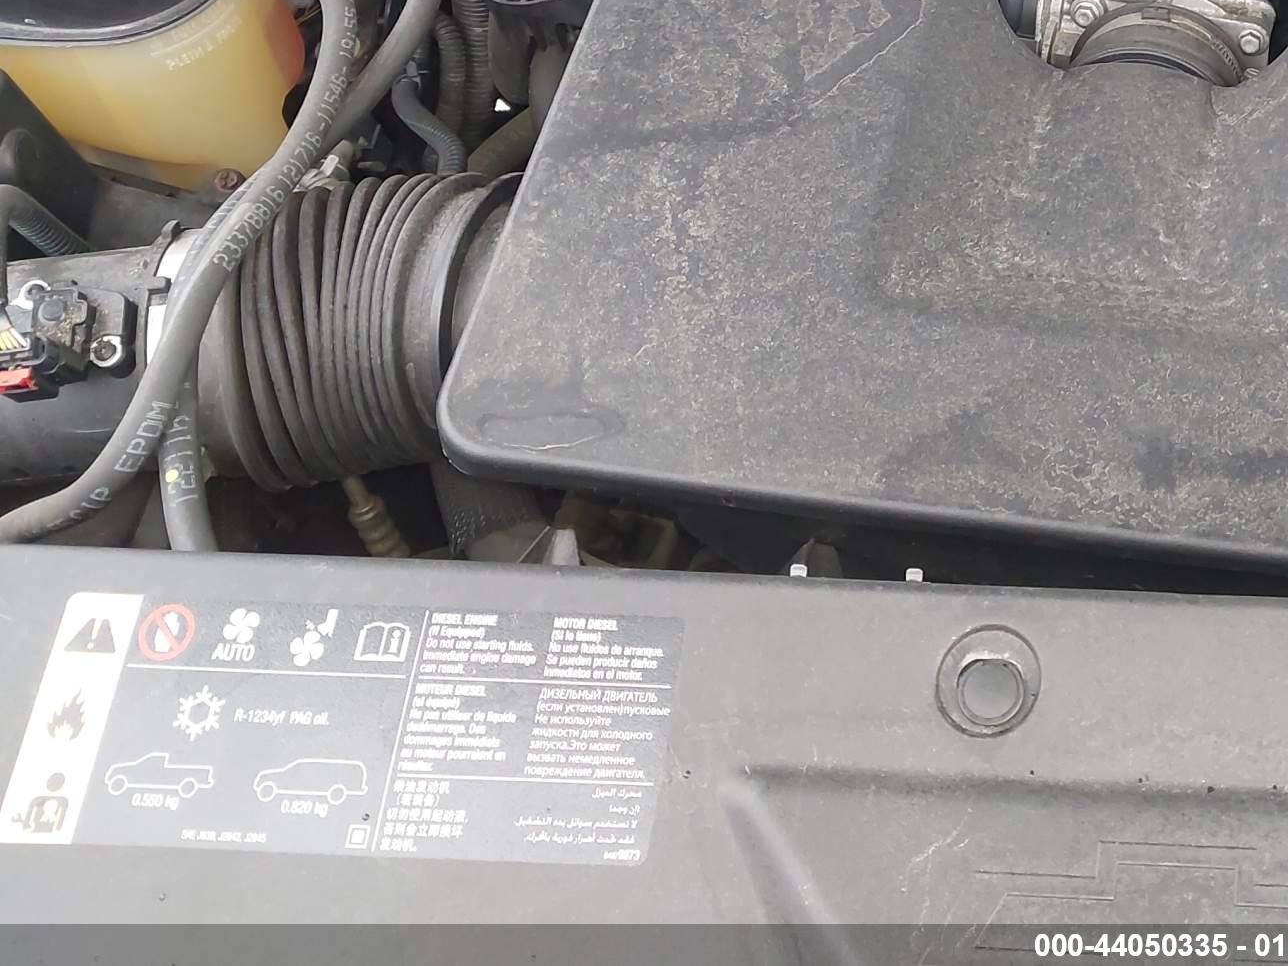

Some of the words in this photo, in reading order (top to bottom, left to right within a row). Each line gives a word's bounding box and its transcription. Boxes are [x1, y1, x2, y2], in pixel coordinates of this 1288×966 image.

[114, 401, 170, 473] EPDM
[432, 613, 462, 624] DIESEL
[464, 614, 498, 626] ENGINE
[553, 617, 586, 629] MOTOR
[587, 619, 618, 631] DIESEL
[211, 643, 255, 661] AUTO
[426, 637, 438, 648] Do
[439, 639, 454, 649] not
[455, 641, 472, 650] use
[473, 640, 507, 653] starting
[508, 641, 534, 652] fluids.
[549, 641, 561, 653] No
[562, 644, 579, 653] use
[580, 643, 609, 655] fluidos
[610, 645, 623, 655] de
[623, 646, 664, 658] arranque.
[470, 652, 500, 665] engine
[501, 653, 537, 667] damage
[546, 654, 558, 665] Se
[559, 655, 591, 667] pueden
[592, 656, 630, 669] producir
[631, 658, 658, 669] daños
[420, 664, 437, 673] can
[592, 670, 605, 680] en
[605, 669, 615, 679] el
[616, 671, 642, 681] motor.
[415, 682, 453, 695] MOTEUR
[454, 684, 486, 697] DIESEL
[539, 687, 601, 702] ДИЗЕЛЬНЫЙ
[602, 690, 658, 704] ДВИГАТЕЛЬ
[537, 700, 563, 714] (если
[234, 708, 285, 726] R-1234yf
[289, 711, 312, 724] PAG
[535, 714, 550, 724] Не
[551, 715, 611, 727] используйте
[531, 728, 579, 739] жидкости
[580, 730, 600, 740] для
[601, 731, 652, 742] холодного
[588, 742, 620, 752] может
[568, 754, 636, 767] немедленное
[523, 766, 593, 779] повреждение
[593, 768, 645, 780] двигателя.
[164, 794, 180, 811] kg
[313, 802, 329, 818] kg
